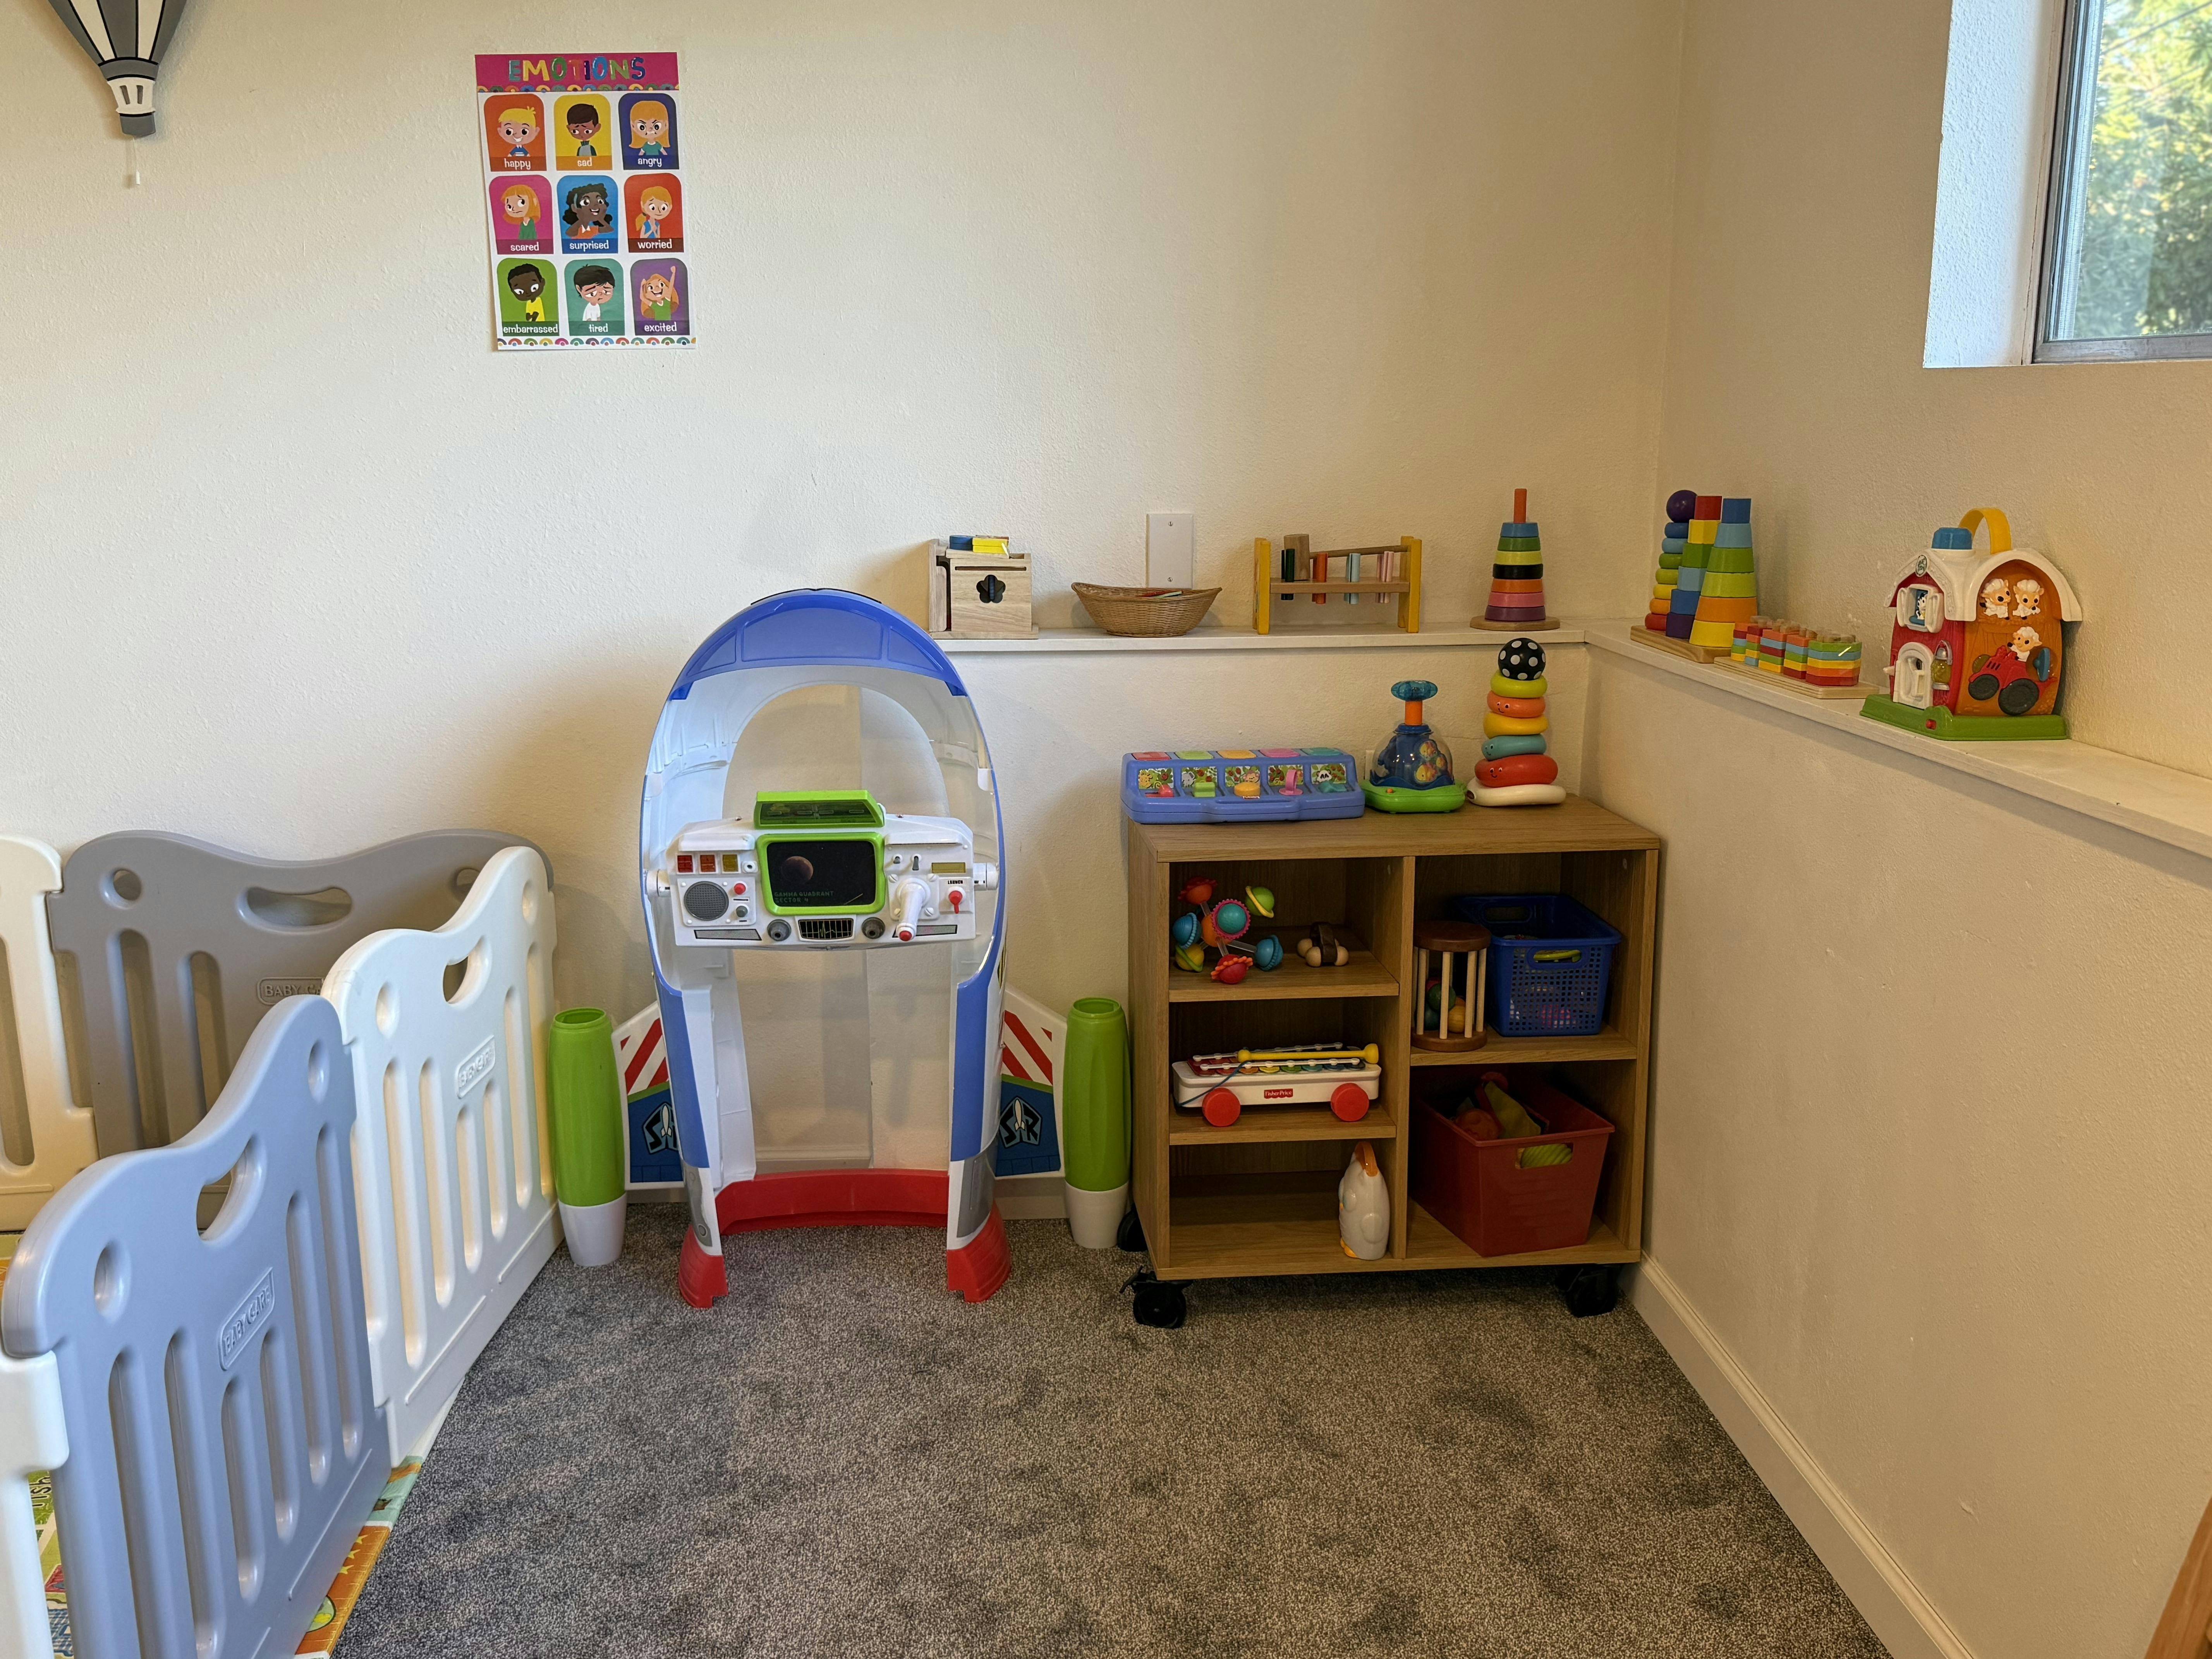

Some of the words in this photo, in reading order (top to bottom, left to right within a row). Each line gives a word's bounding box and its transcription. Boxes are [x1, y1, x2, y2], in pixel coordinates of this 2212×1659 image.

[508, 56, 646, 82] EMOTIONS
[504, 158, 531, 170] happy
[577, 157, 592, 167] sad
[637, 157, 662, 168] angry
[510, 241, 539, 252] scared
[570, 240, 609, 252] surprised
[637, 238, 672, 249] worried
[503, 324, 558, 334] embarrassed
[589, 323, 608, 333] tired
[644, 322, 677, 332] excited
[264, 984, 301, 996] BABY
[223, 1313, 247, 1357] BABY
[247, 1285, 270, 1324] CARE
